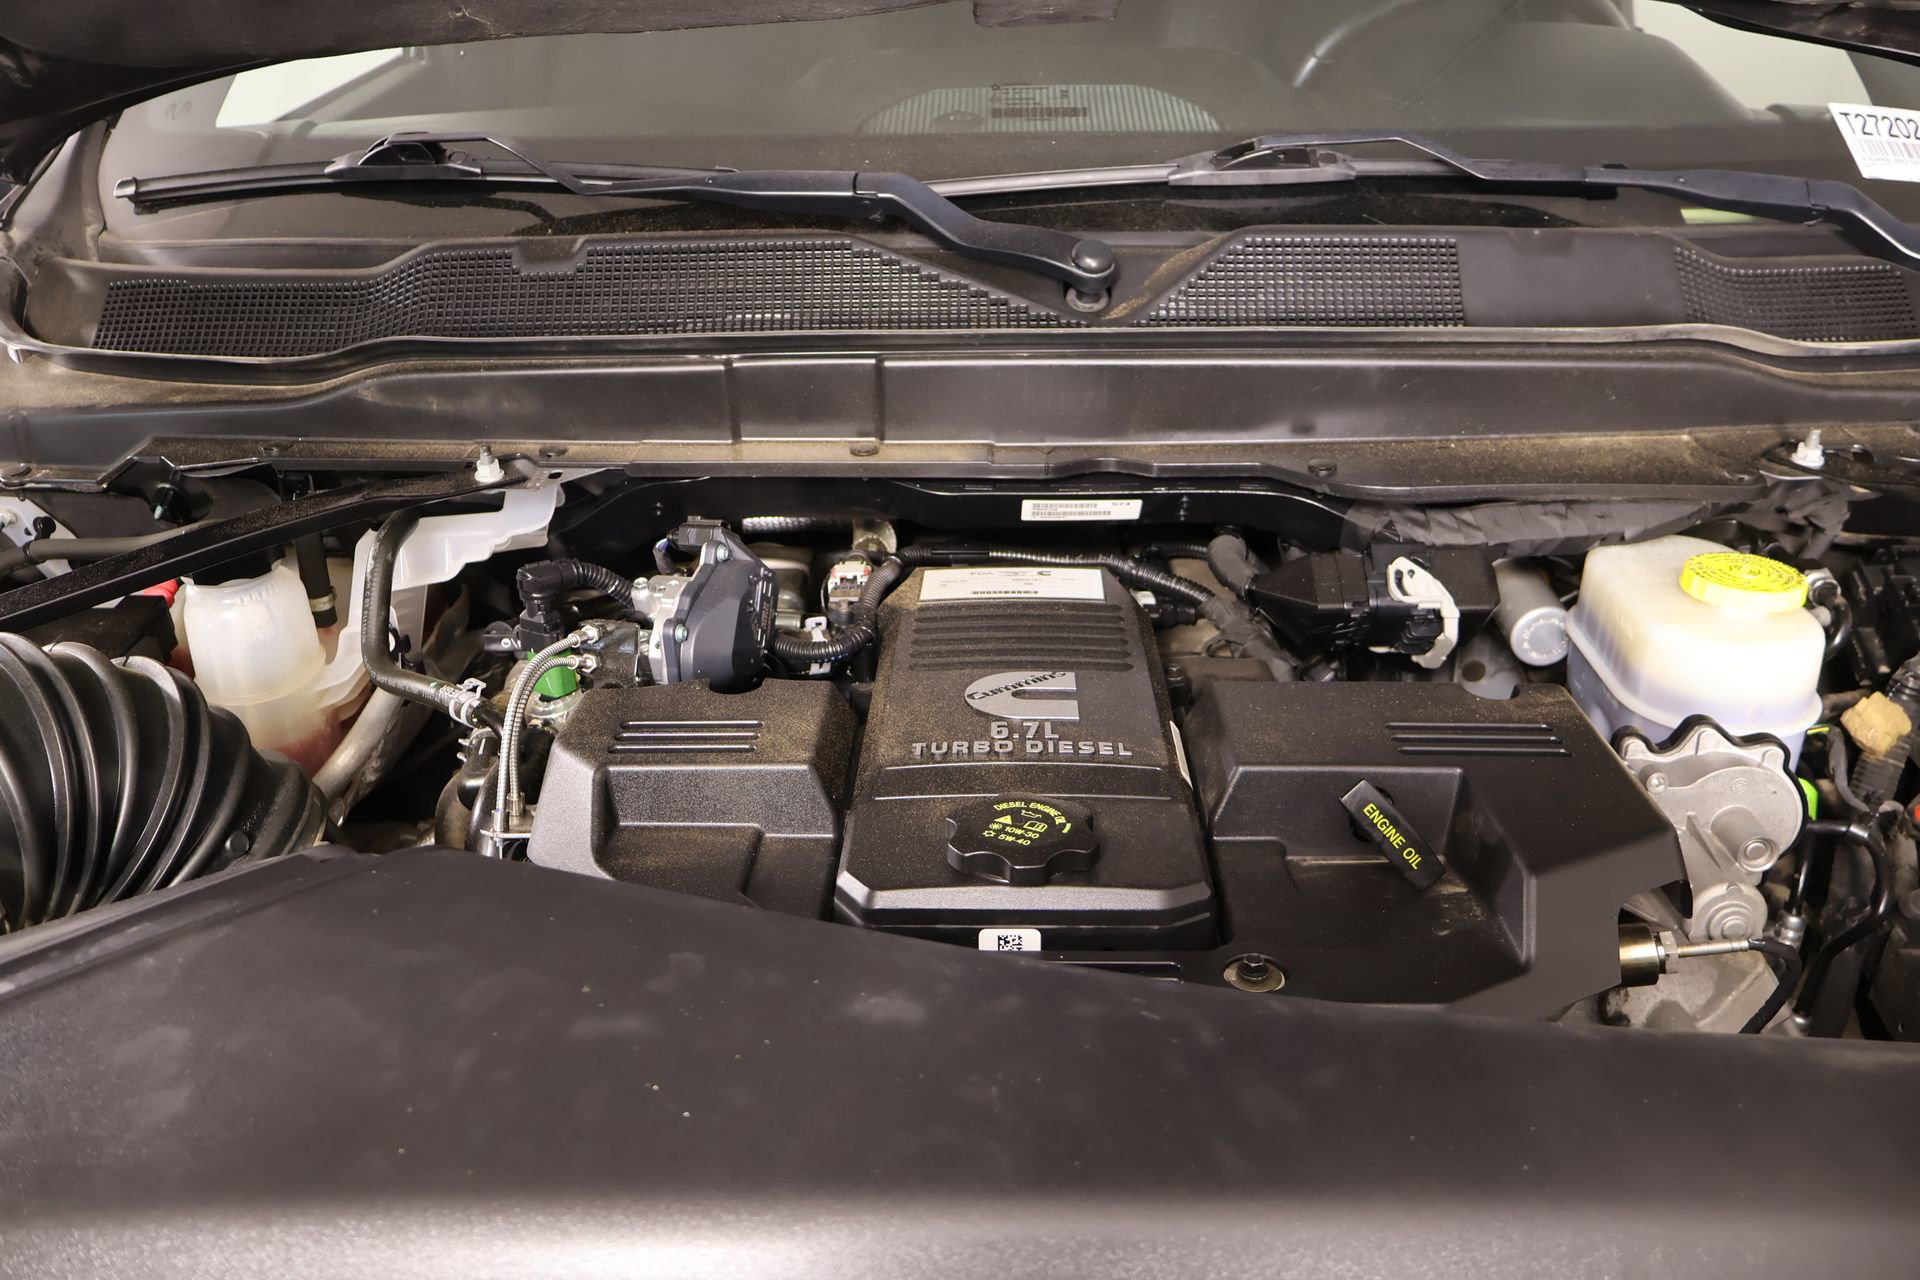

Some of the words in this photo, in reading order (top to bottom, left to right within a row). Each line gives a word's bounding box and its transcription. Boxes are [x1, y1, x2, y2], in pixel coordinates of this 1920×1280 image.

[1839, 112, 1920, 140] T27202
[967, 671, 1067, 700] Cummins
[990, 721, 1060, 740] 6.7L
[912, 739, 1015, 757] TURBO
[1025, 740, 1133, 757] DIESEL
[993, 801, 1027, 811] DIESEL
[1028, 802, 1062, 817] ENGINE
[998, 834, 1031, 846] 5W-40
[1004, 826, 1040, 839] 10W-30
[1363, 803, 1406, 849] ENGINE
[1402, 847, 1422, 870] OIL
